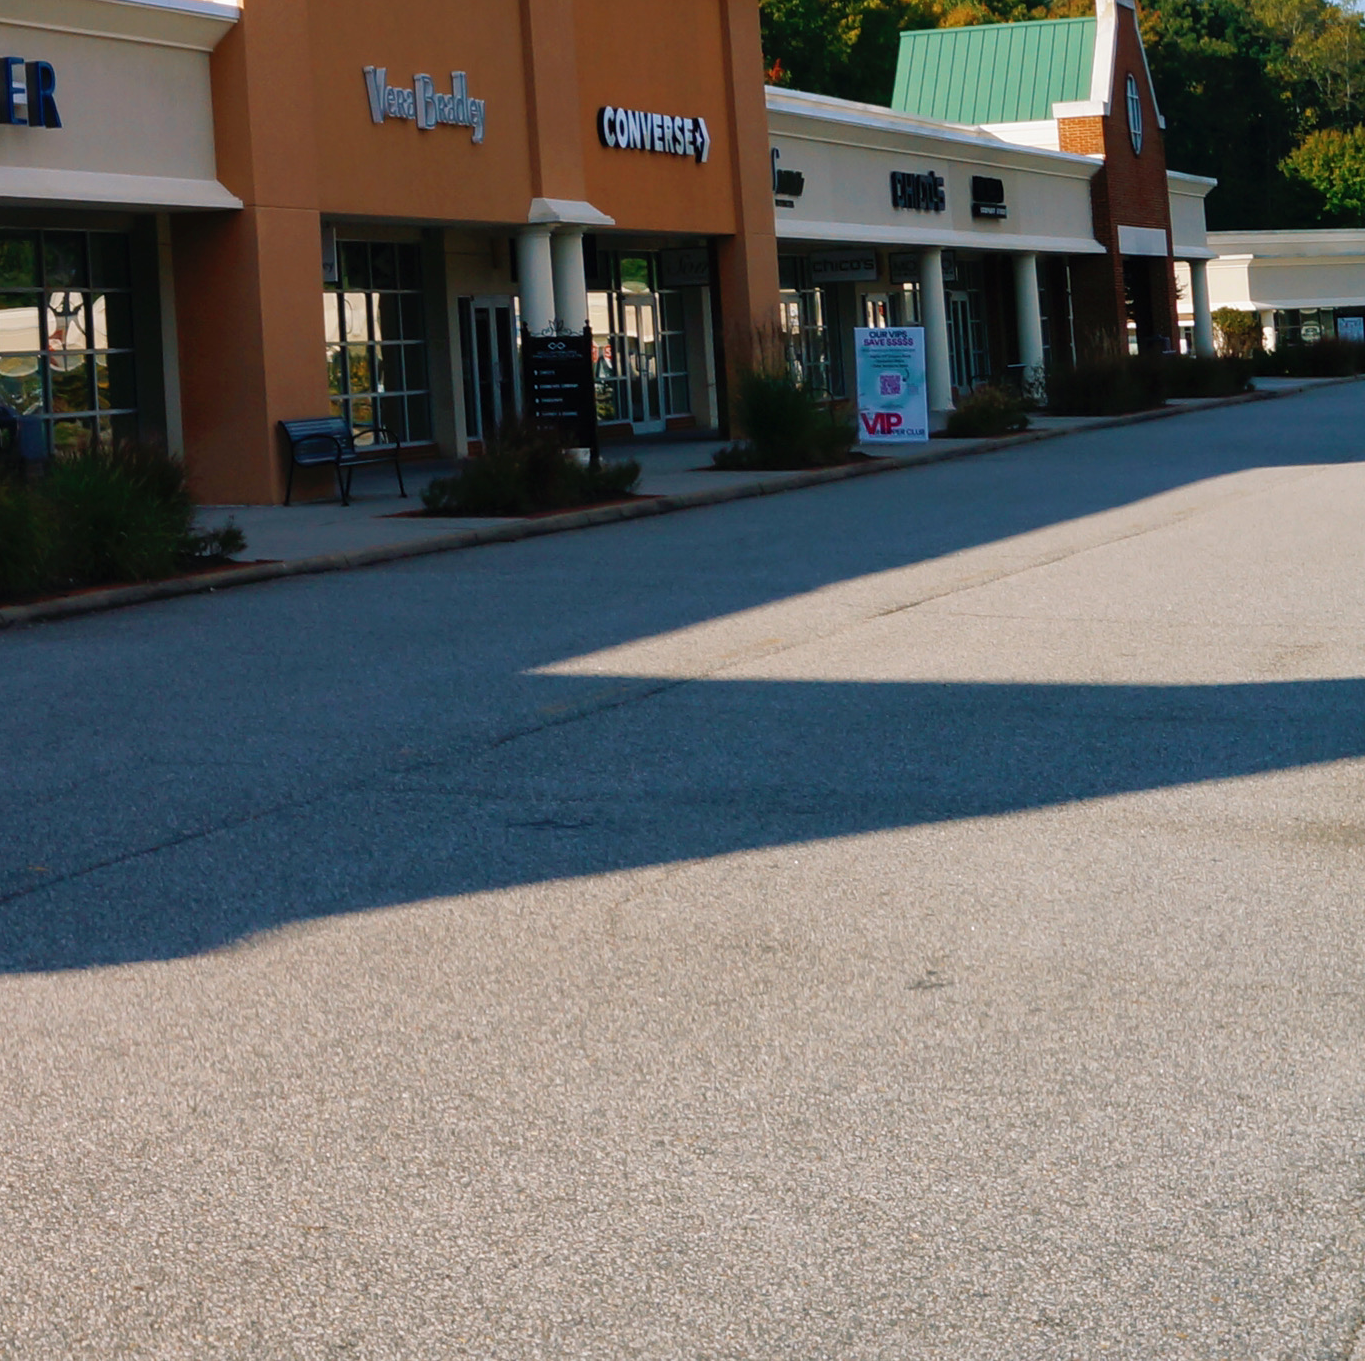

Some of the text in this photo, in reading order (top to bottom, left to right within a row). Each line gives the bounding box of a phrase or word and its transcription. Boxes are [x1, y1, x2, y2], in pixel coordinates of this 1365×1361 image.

[363, 65, 485, 143] Vera Bradley
[598, 105, 694, 156] CONVERSE
[861, 413, 902, 435] VIP
